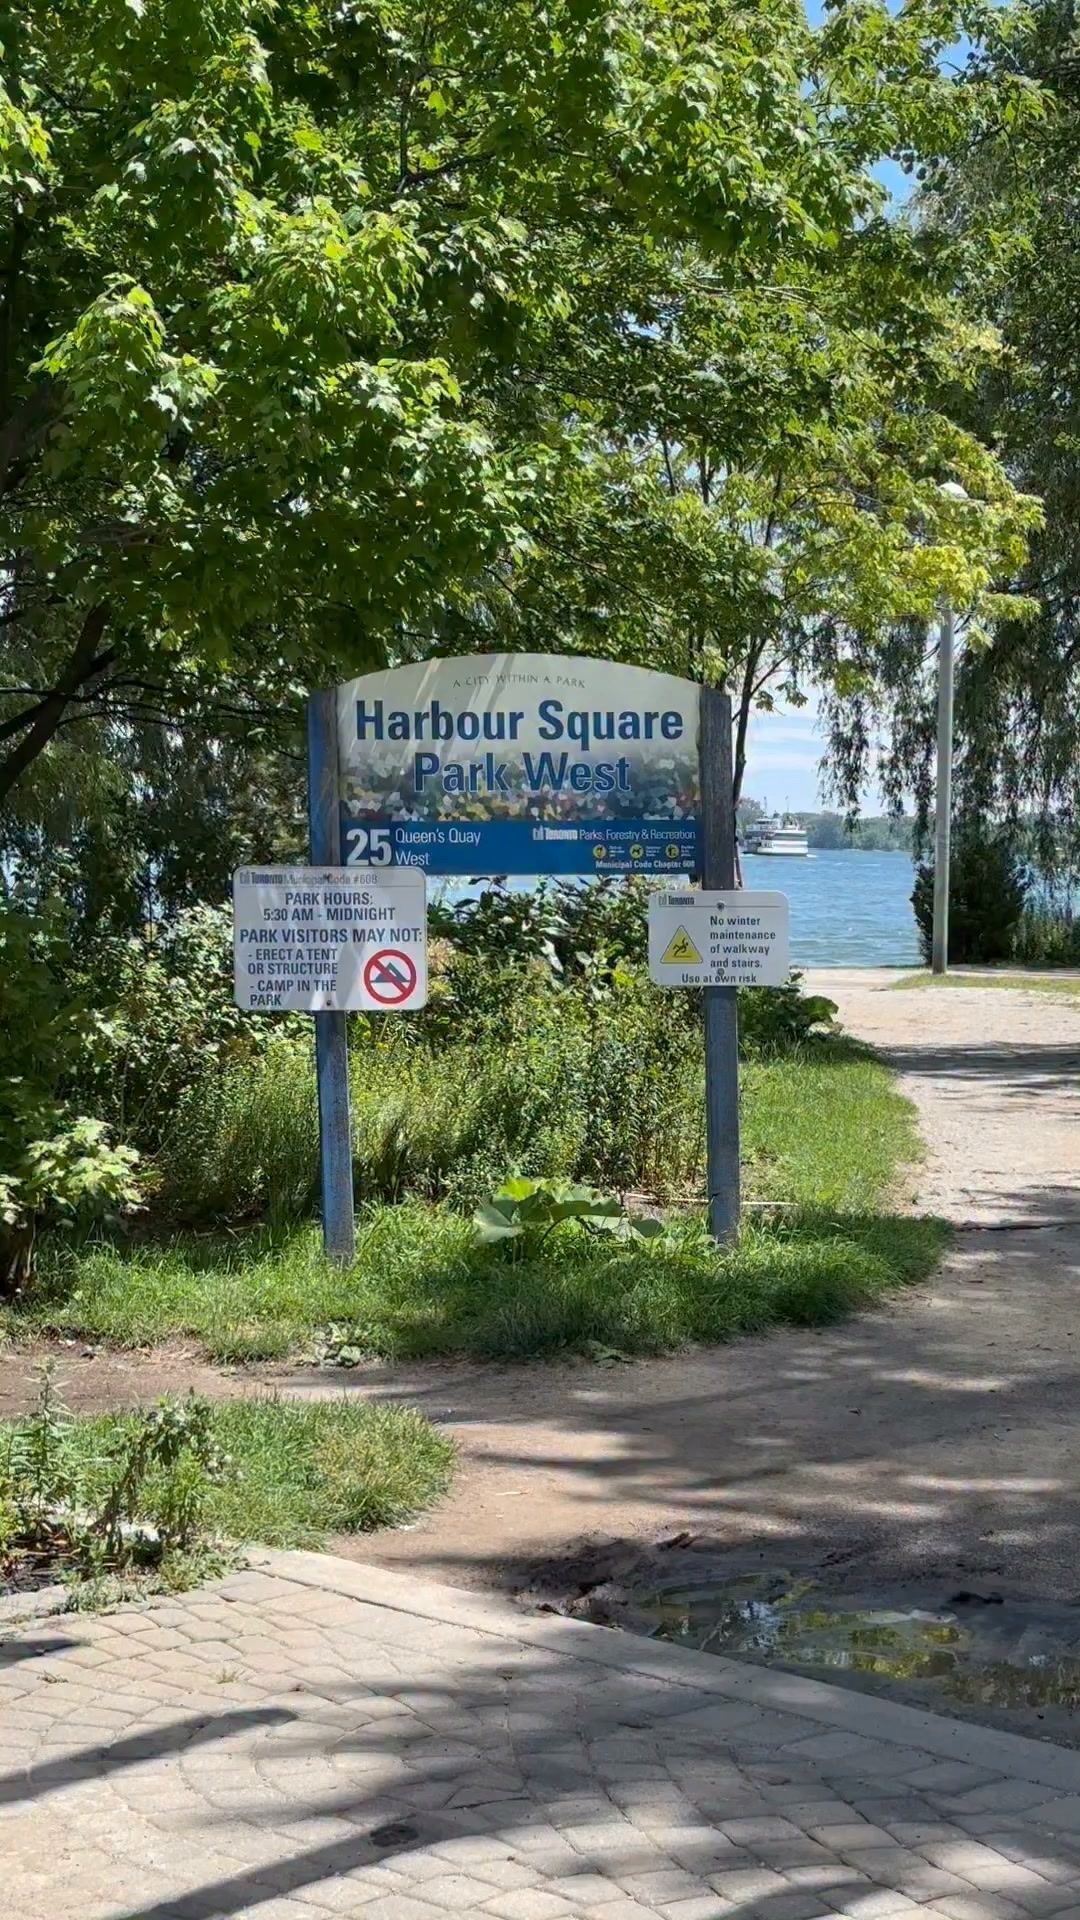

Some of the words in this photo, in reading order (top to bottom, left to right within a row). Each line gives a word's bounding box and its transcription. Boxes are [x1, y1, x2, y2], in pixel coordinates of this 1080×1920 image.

[452, 680, 460, 688] A
[466, 676, 489, 686] CITY
[496, 674, 538, 684] WITHIN
[543, 675, 552, 684] A
[556, 676, 586, 688] PARK
[356, 700, 524, 741] Harbour
[538, 699, 684, 751] Square
[414, 752, 509, 792] Park
[522, 752, 633, 792] West
[579, 830, 604, 841] Parks,
[606, 830, 639, 843] Forestry
[641, 830, 649, 840] &
[650, 829, 696, 840] Recreation
[346, 828, 392, 867] 25
[396, 828, 445, 844] Queen's
[448, 828, 481, 846] Quay
[396, 851, 430, 866] West
[596, 860, 632, 870] Municipal
[634, 860, 652, 868] Code
[653, 860, 681, 870] Chapter
[286, 892, 320, 905] PARK
[324, 892, 373, 905] HOURS:
[264, 908, 288, 921] 5:30
[292, 908, 313, 921] AM
[327, 908, 395, 921] MIDNIGHT
[710, 916, 724, 926] No
[728, 916, 760, 926] winter
[240, 929, 278, 943] PARK
[282, 928, 348, 943] VISITORS
[353, 928, 386, 942] MAY
[390, 928, 422, 942] NOT:
[710, 929, 776, 940] maintenance
[256, 949, 294, 960] ERECT
[296, 949, 304, 960] A
[304, 948, 338, 960] TENT
[710, 943, 720, 954] of
[723, 943, 770, 956] walkway
[248, 963, 264, 974] OR
[268, 963, 338, 975] STRUCTURE
[710, 958, 728, 968] and
[732, 958, 762, 968] stairs.
[682, 973, 700, 984] Use
[702, 974, 712, 984] at
[714, 974, 736, 983] own
[738, 972, 756, 983] risk
[258, 980, 294, 992] CAMP
[298, 980, 310, 992] IN
[314, 980, 336, 992] THE
[250, 994, 282, 1006] PARK
